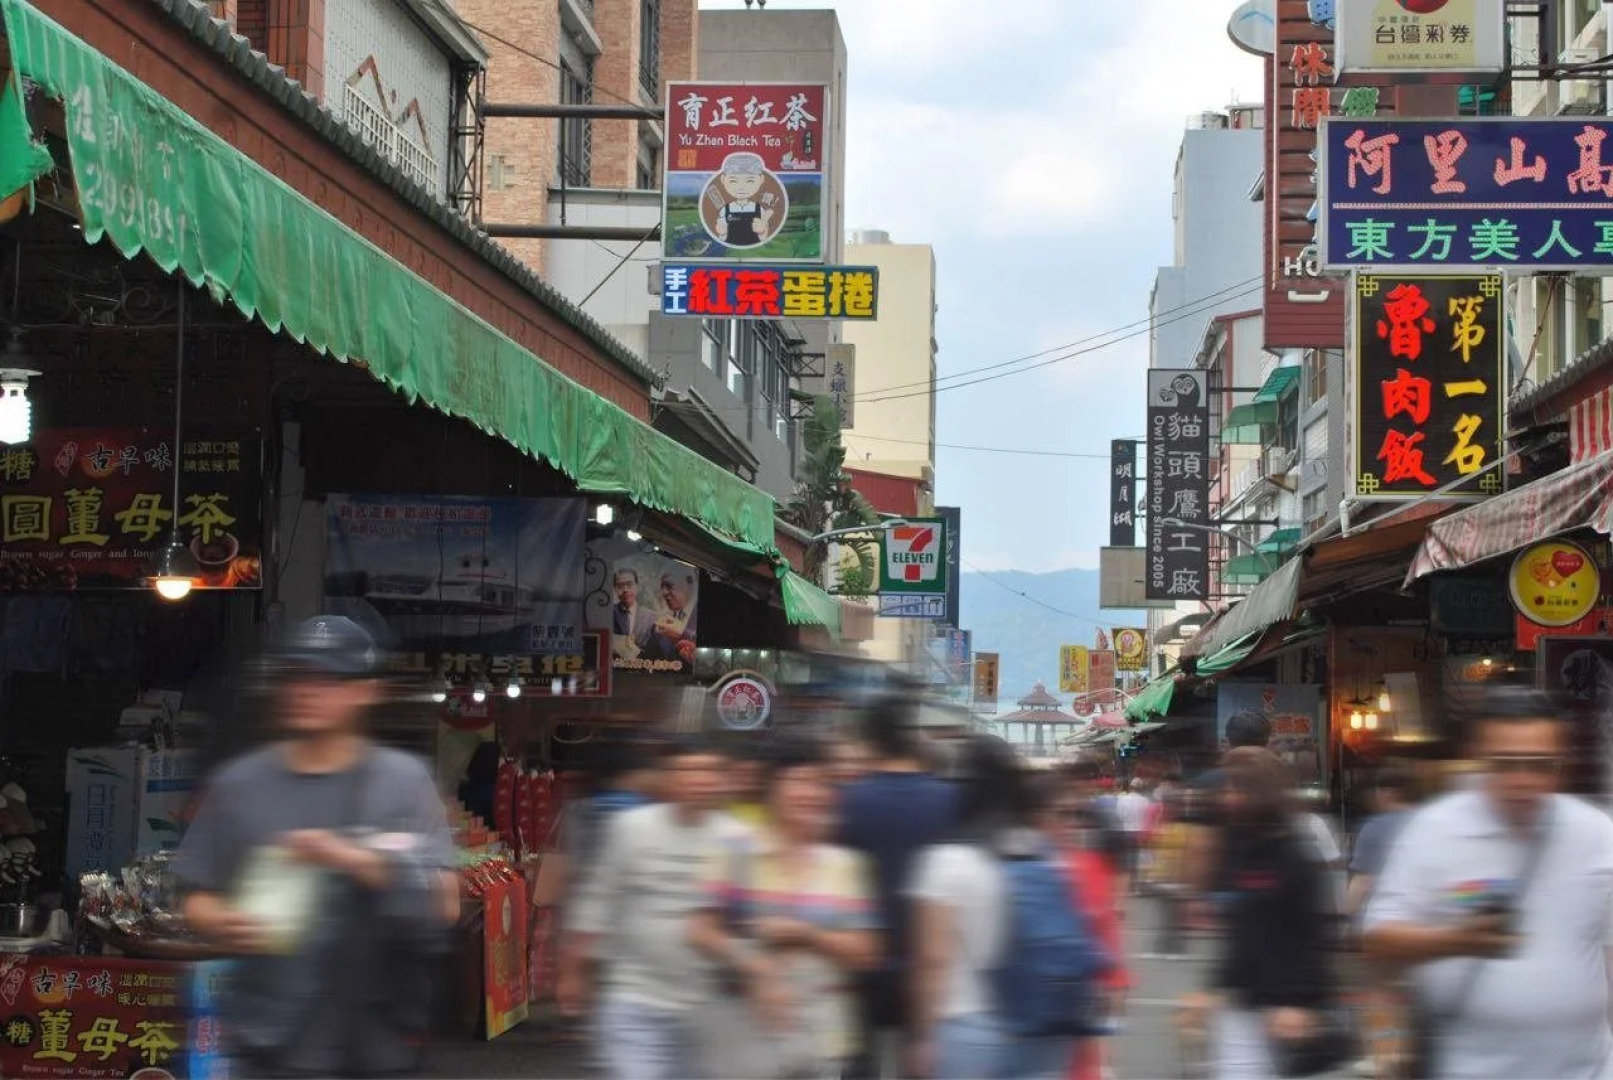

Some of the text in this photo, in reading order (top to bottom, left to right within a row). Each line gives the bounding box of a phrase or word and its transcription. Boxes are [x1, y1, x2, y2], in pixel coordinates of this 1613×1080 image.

[1376, 24, 1470, 44] 台灣彩券
[678, 134, 692, 146] Yu
[727, 134, 758, 147] Black
[762, 134, 781, 147] Tea
[665, 268, 687, 314] 手工
[688, 269, 874, 317] 紅茶蛋捲
[1376, 283, 1437, 486] 魯肉飯
[1442, 295, 1488, 475] 第一名
[1153, 415, 1165, 441] Owl
[84, 442, 173, 476] 古早味
[1153, 444, 1166, 513] Workshop
[2, 487, 237, 546] 圓薑母茶
[1167, 412, 1202, 596] 貓頭鷹工廠
[70, 550, 102, 561] Ginger
[892, 526, 934, 551] 7
[1153, 556, 1165, 588] 2005
[30, 967, 115, 999] 古早味
[33, 1008, 180, 1066] 薑母茶
[78, 1066, 105, 1077] Ginger
